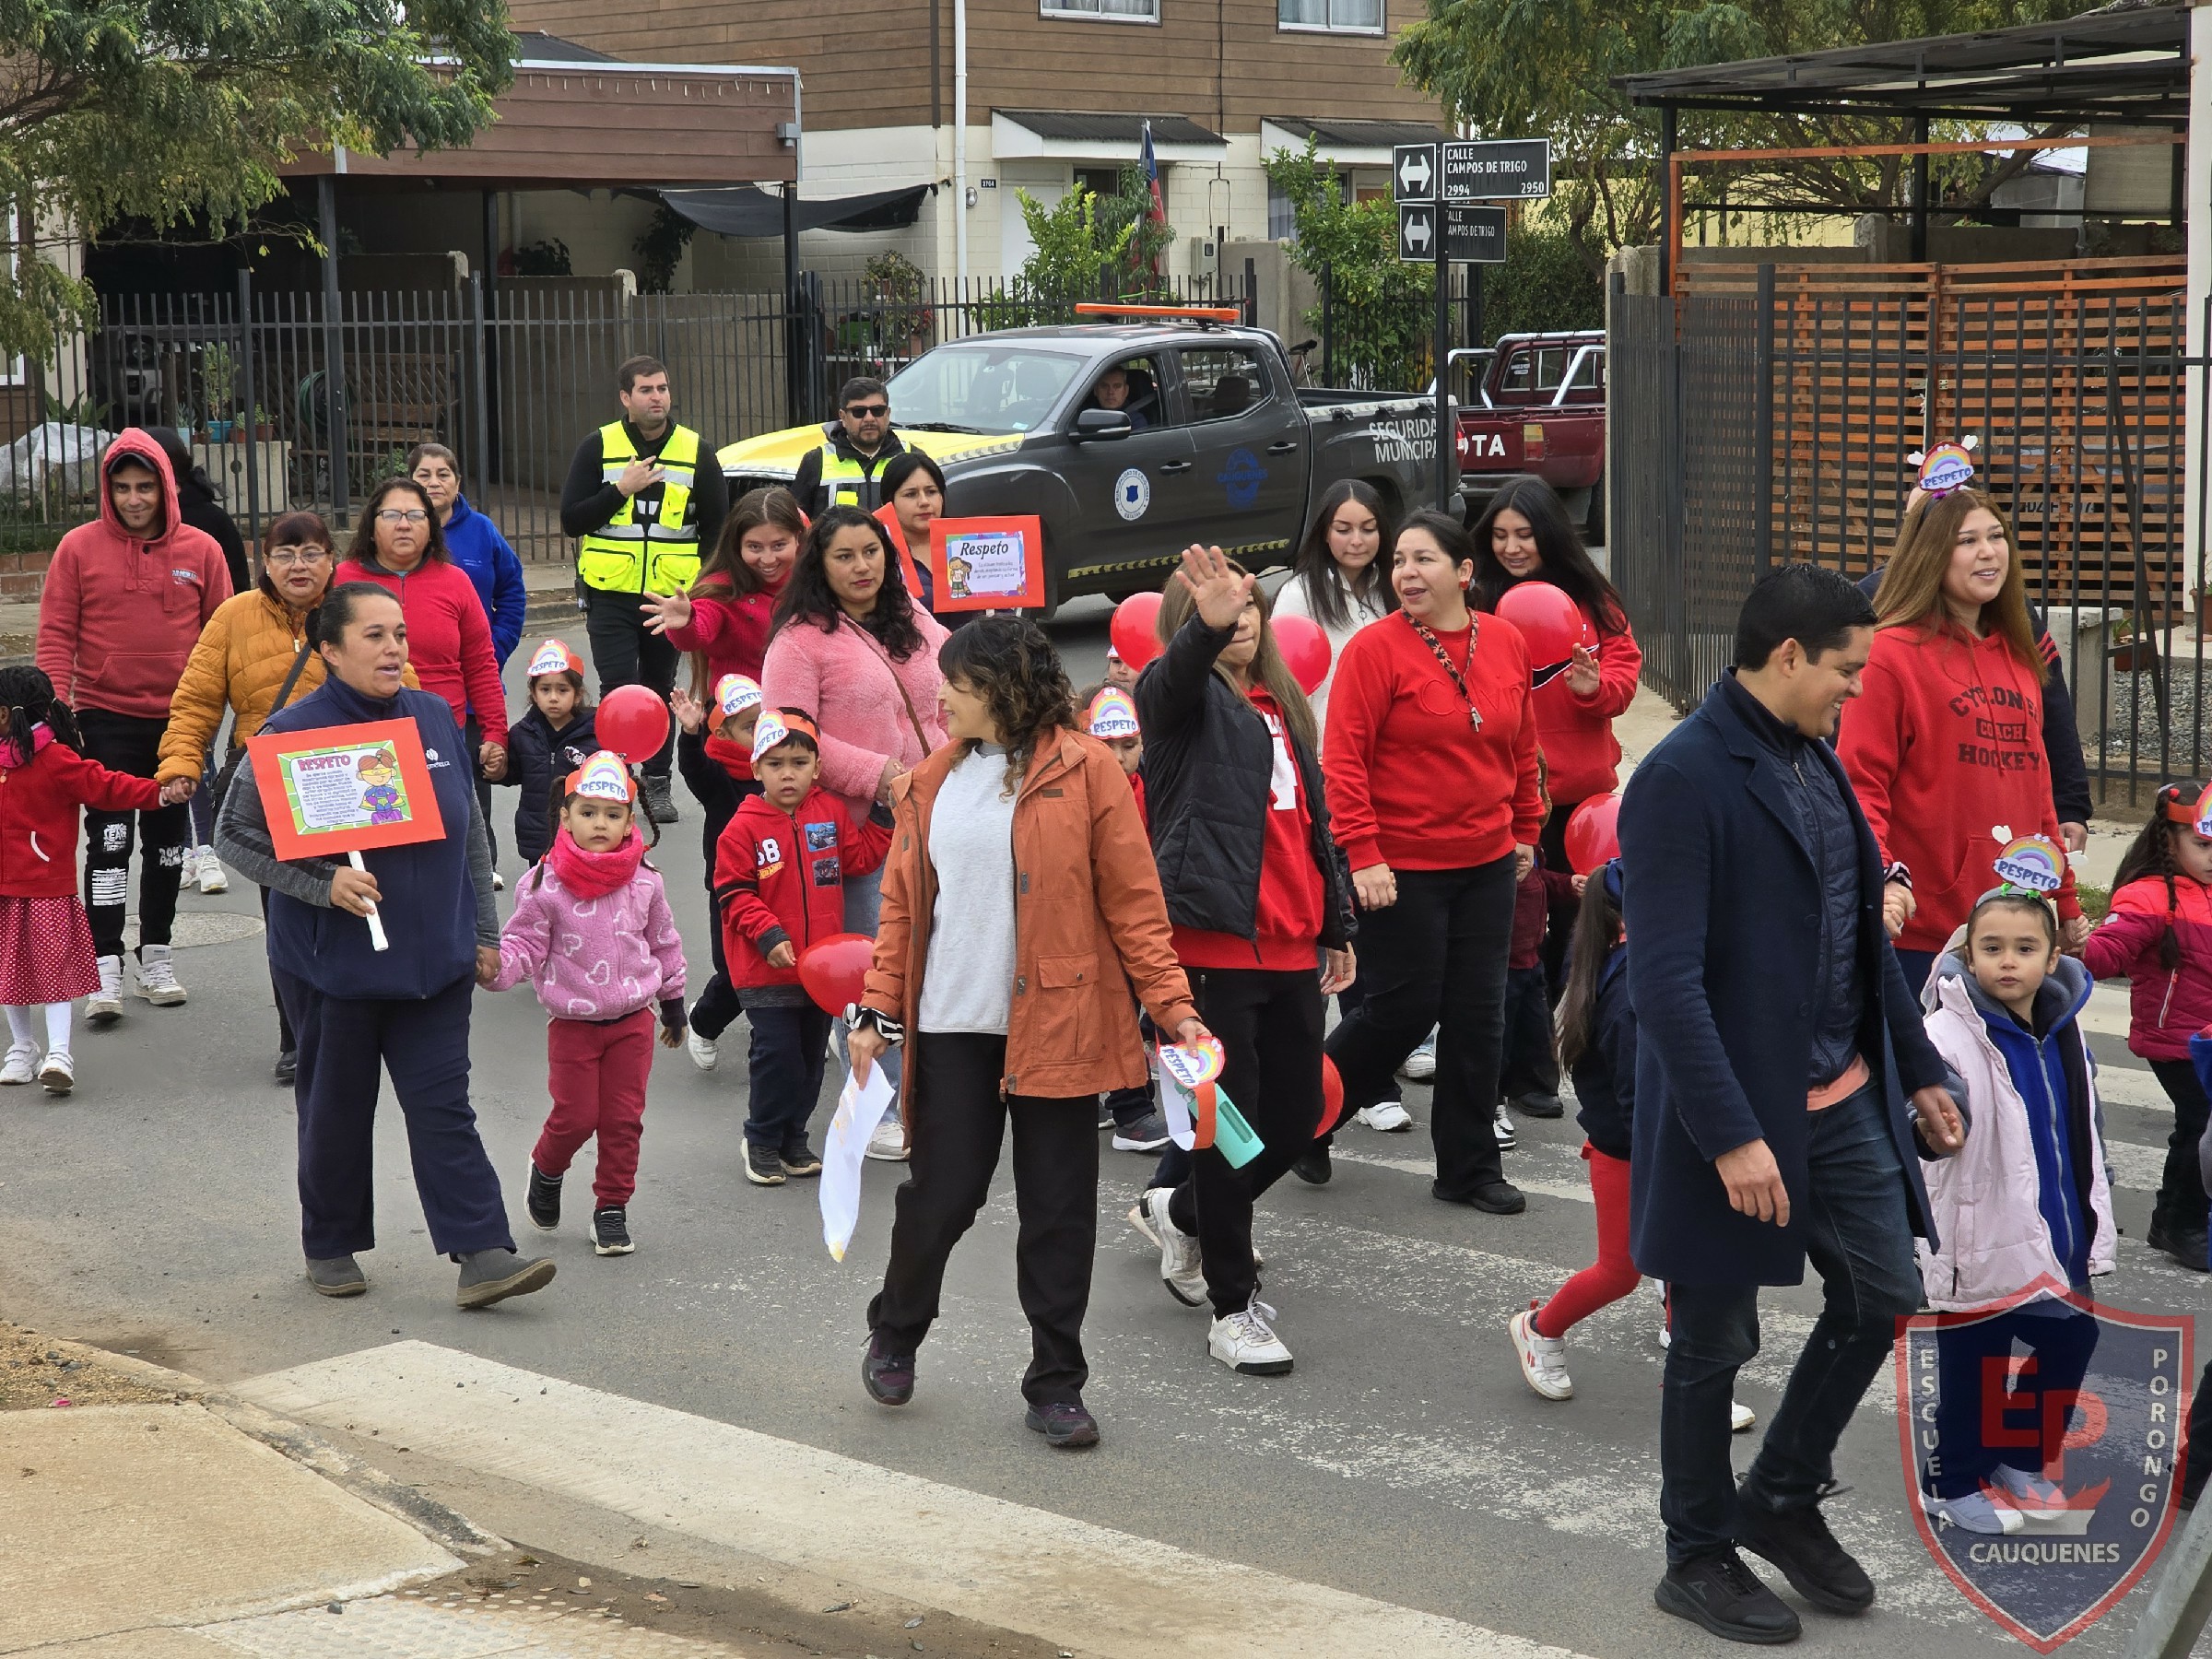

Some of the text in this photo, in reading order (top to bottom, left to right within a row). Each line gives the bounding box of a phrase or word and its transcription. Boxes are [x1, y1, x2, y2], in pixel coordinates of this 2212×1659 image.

[1447, 147, 1474, 160] CALLE
[1447, 160, 1527, 174] CAMPOS DE TRIGO
[1447, 182, 1545, 196] 2994 2950
[1447, 210, 1463, 222] ALLE
[1447, 225, 1495, 237] AMPOS DE TRIGO
[1369, 418, 1437, 441] SEGURIDA
[1374, 439, 1437, 463] MUNICIPA
[1924, 467, 1971, 488] RESPETO
[960, 541, 1008, 559] Respeto
[1093, 719, 1136, 734] RESPETO
[1980, 721, 2024, 740] COCH
[297, 754, 351, 772] RESPETO
[581, 781, 626, 799] RESPETO
[1998, 860, 2059, 889] RESPETO
[1164, 1048, 1195, 1084] RESPETO
